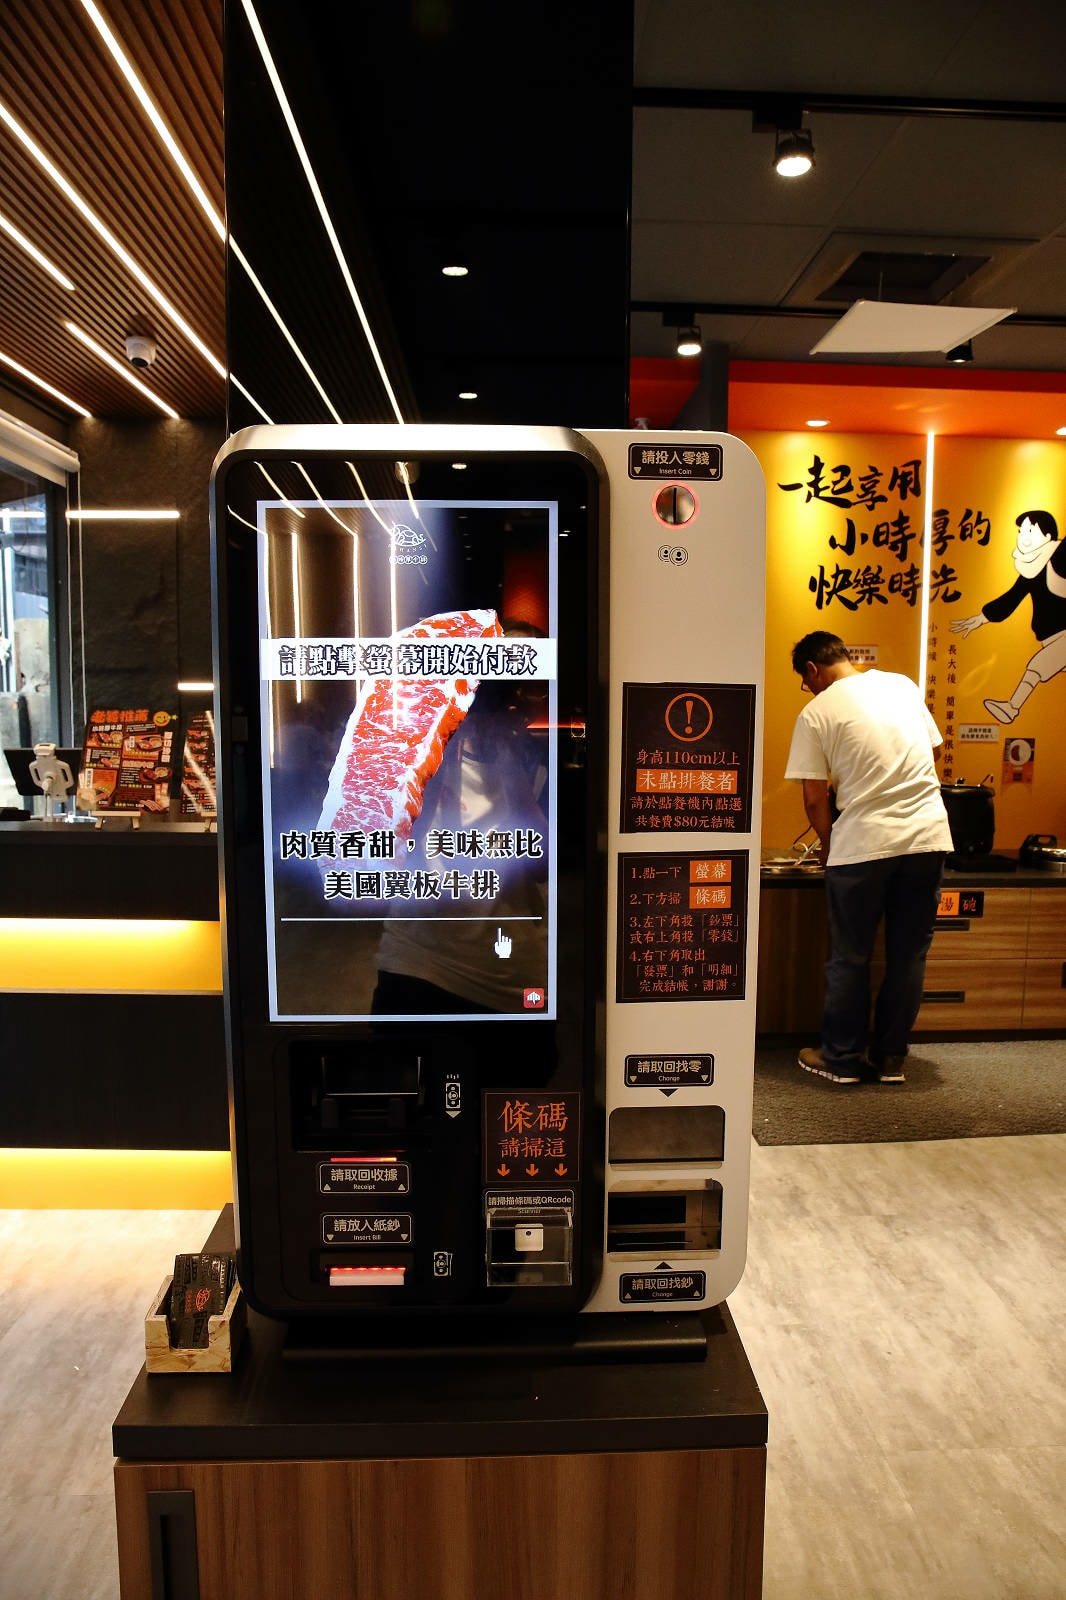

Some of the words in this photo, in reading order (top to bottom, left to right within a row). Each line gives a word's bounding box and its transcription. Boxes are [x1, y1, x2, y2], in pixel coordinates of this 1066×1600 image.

[641, 450, 710, 466] 請投入零錢
[658, 467, 677, 475] Insert
[678, 467, 693, 475] Coin
[777, 454, 923, 511] 一起享用
[808, 563, 962, 611] 快樂時光
[279, 644, 538, 676] 請點擊螢幕開始付款
[947, 645, 957, 684] 長大後
[636, 748, 741, 766] 身高110cm以上
[638, 770, 735, 791] 未點排餐者
[630, 795, 743, 812] 請於點餐機內點選
[635, 814, 736, 829] 共餐費$80元結帳
[280, 829, 544, 860] 肉質香甜，美味無比
[695, 862, 727, 879] 螢幕
[324, 868, 501, 901] 美國翼板牛排
[695, 888, 727, 905] 條碼
[630, 948, 705, 962] 4.右下角取出
[637, 1059, 702, 1074] 請取回找零
[658, 1075, 680, 1083] Change
[497, 1098, 569, 1134] 條碼
[498, 1136, 567, 1159] 請掃這
[330, 1168, 398, 1183] 請取回收據
[353, 1184, 376, 1192] Receipt
[488, 1195, 572, 1206] 請掃描條碼或QRcode
[333, 1218, 401, 1233] 請放入紙鈔
[631, 1277, 693, 1291] 請取回找鈔
